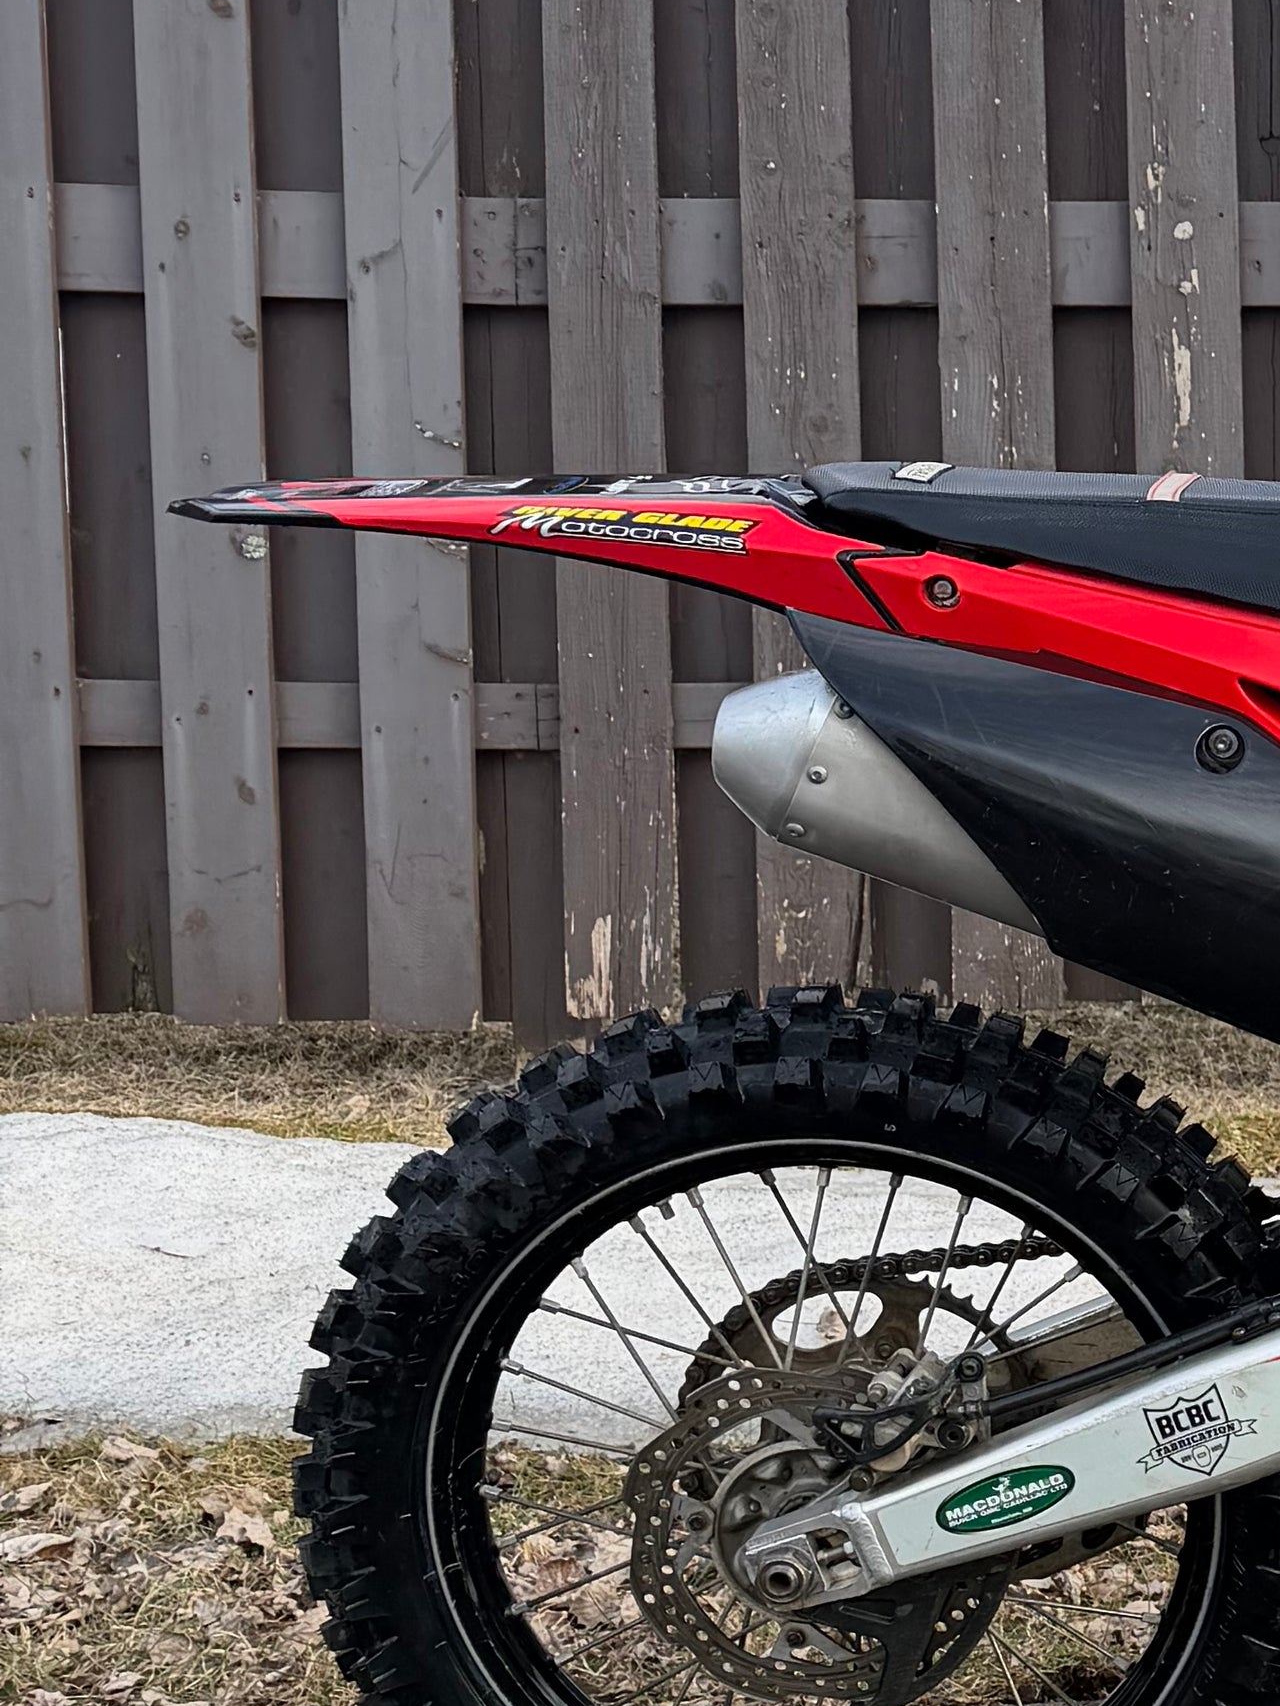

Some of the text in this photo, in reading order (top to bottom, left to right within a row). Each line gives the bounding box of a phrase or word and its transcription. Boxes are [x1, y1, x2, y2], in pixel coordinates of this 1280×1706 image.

[489, 511, 745, 550] Motocross
[632, 511, 754, 533] GLADE
[1155, 1398, 1221, 1440] BCBC
[1155, 1422, 1236, 1457] FABRICATION
[945, 1473, 1065, 1521] MACDONALD
